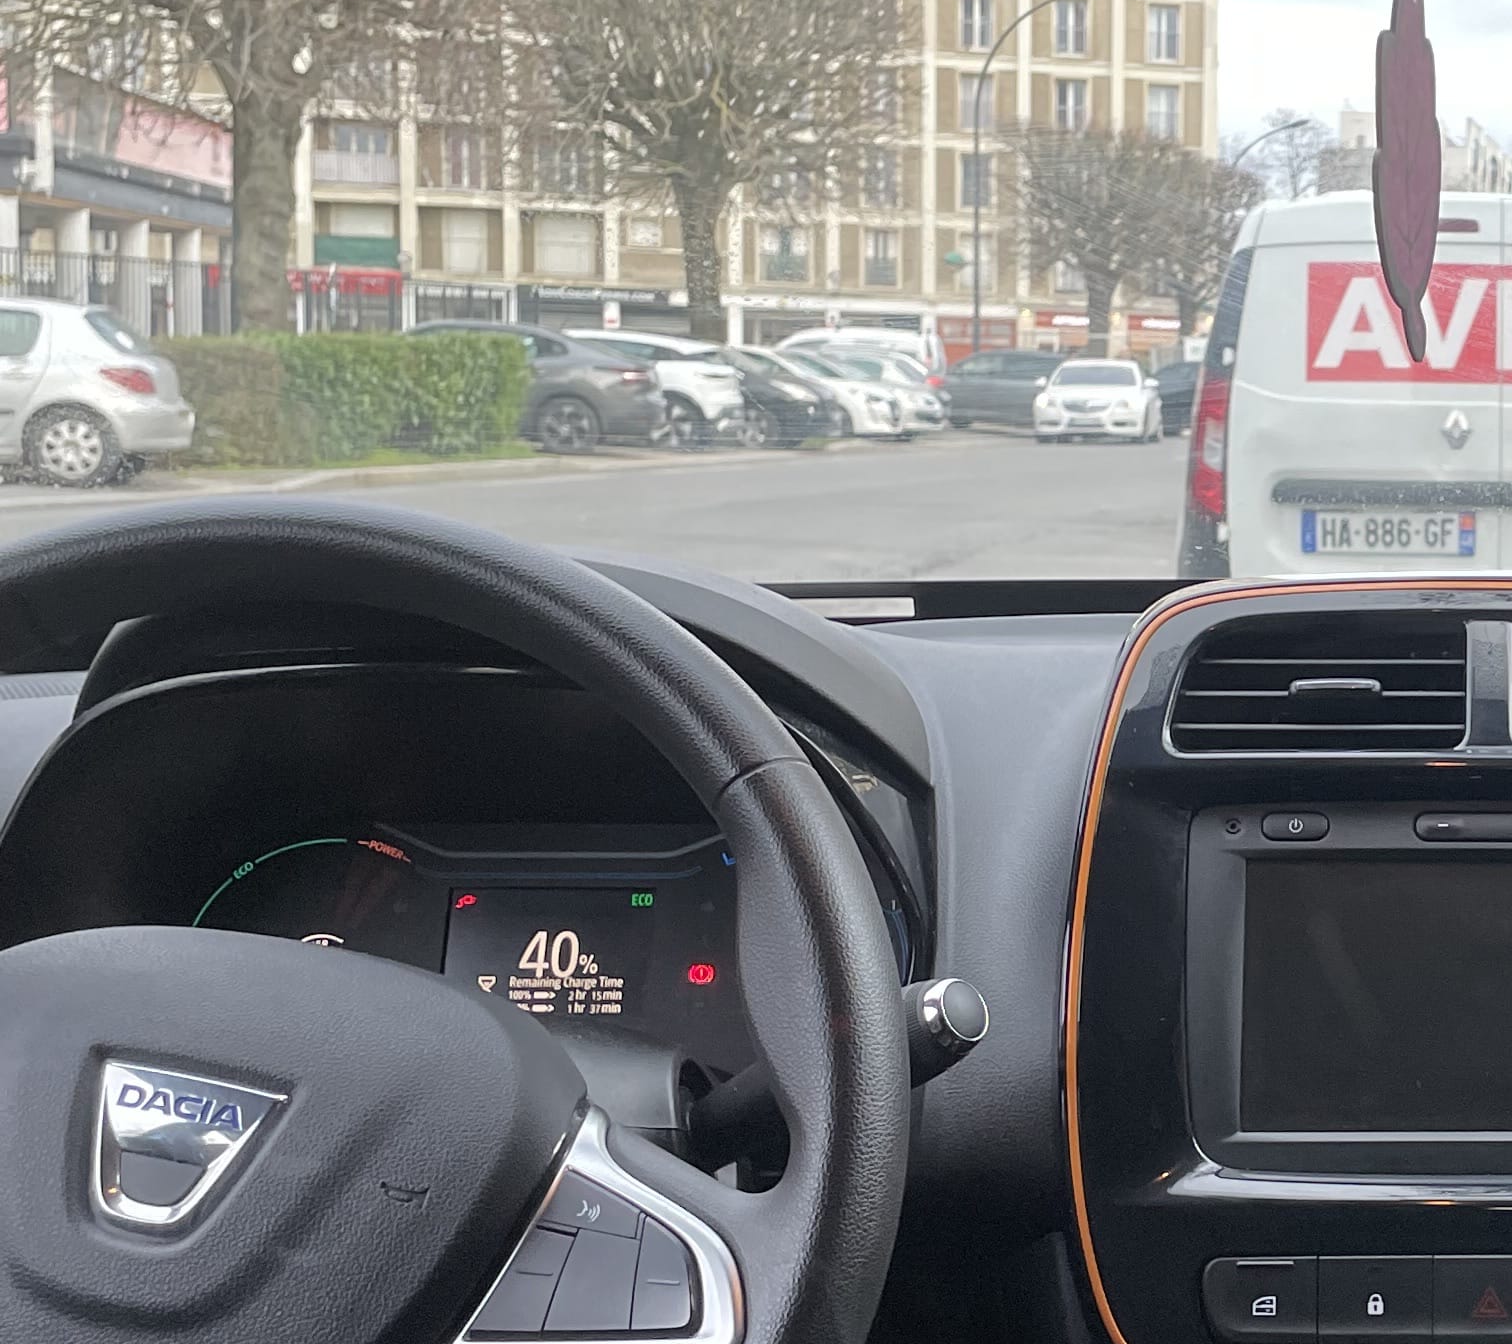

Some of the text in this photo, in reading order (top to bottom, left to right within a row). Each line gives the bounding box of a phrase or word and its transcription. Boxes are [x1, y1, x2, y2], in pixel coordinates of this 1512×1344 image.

[368, 839, 404, 860] POWER
[233, 862, 254, 880] ECO
[631, 894, 654, 907] ECO
[509, 976, 624, 990] Remaining Charge Time
[508, 990, 531, 1001] 100%
[117, 1084, 243, 1131] DACIA
